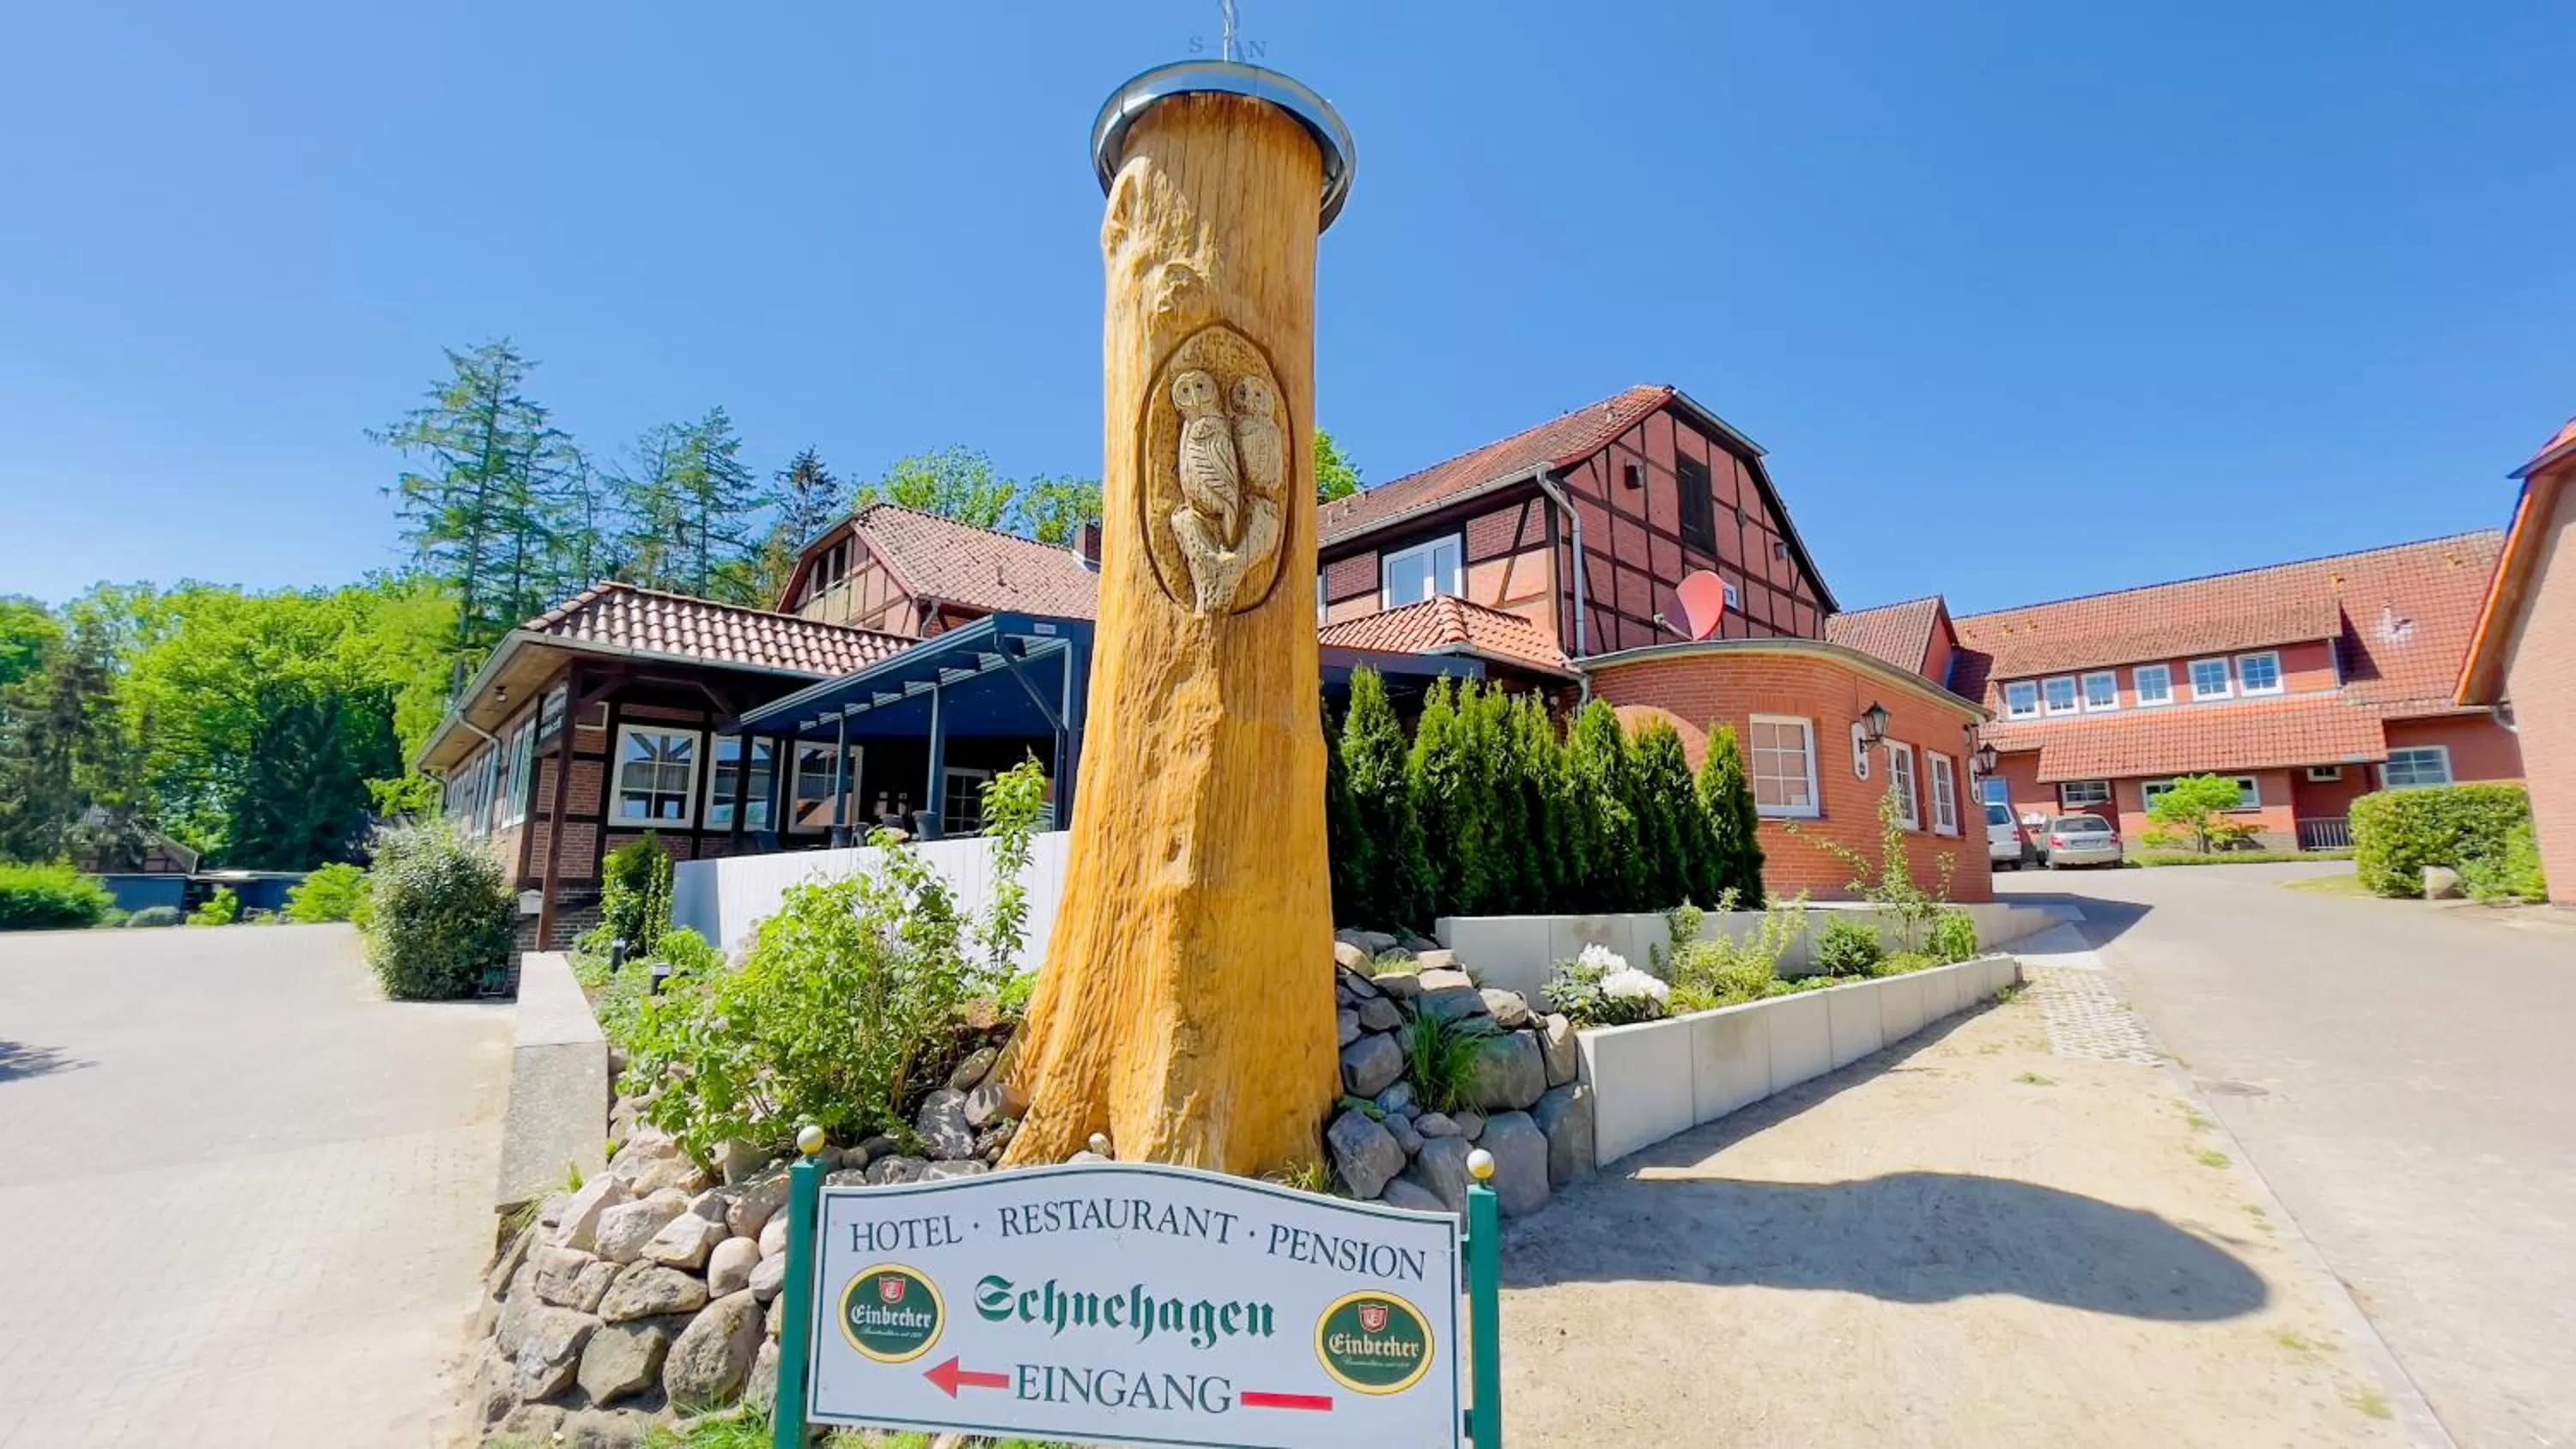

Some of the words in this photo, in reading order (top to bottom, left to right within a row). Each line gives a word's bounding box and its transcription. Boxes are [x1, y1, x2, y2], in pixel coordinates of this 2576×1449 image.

[1188, 36, 1204, 54] S
[1248, 40, 1267, 58] N
[851, 1215, 963, 1252] HOTEL
[998, 1197, 1239, 1245] RESTAURANT
[1267, 1223, 1426, 1282] PENSION
[850, 1304, 932, 1329] Einbecker
[974, 1274, 1275, 1349] Schnehagen
[1328, 1332, 1419, 1358] Einbecker
[1016, 1364, 1233, 1414] EINGANG
